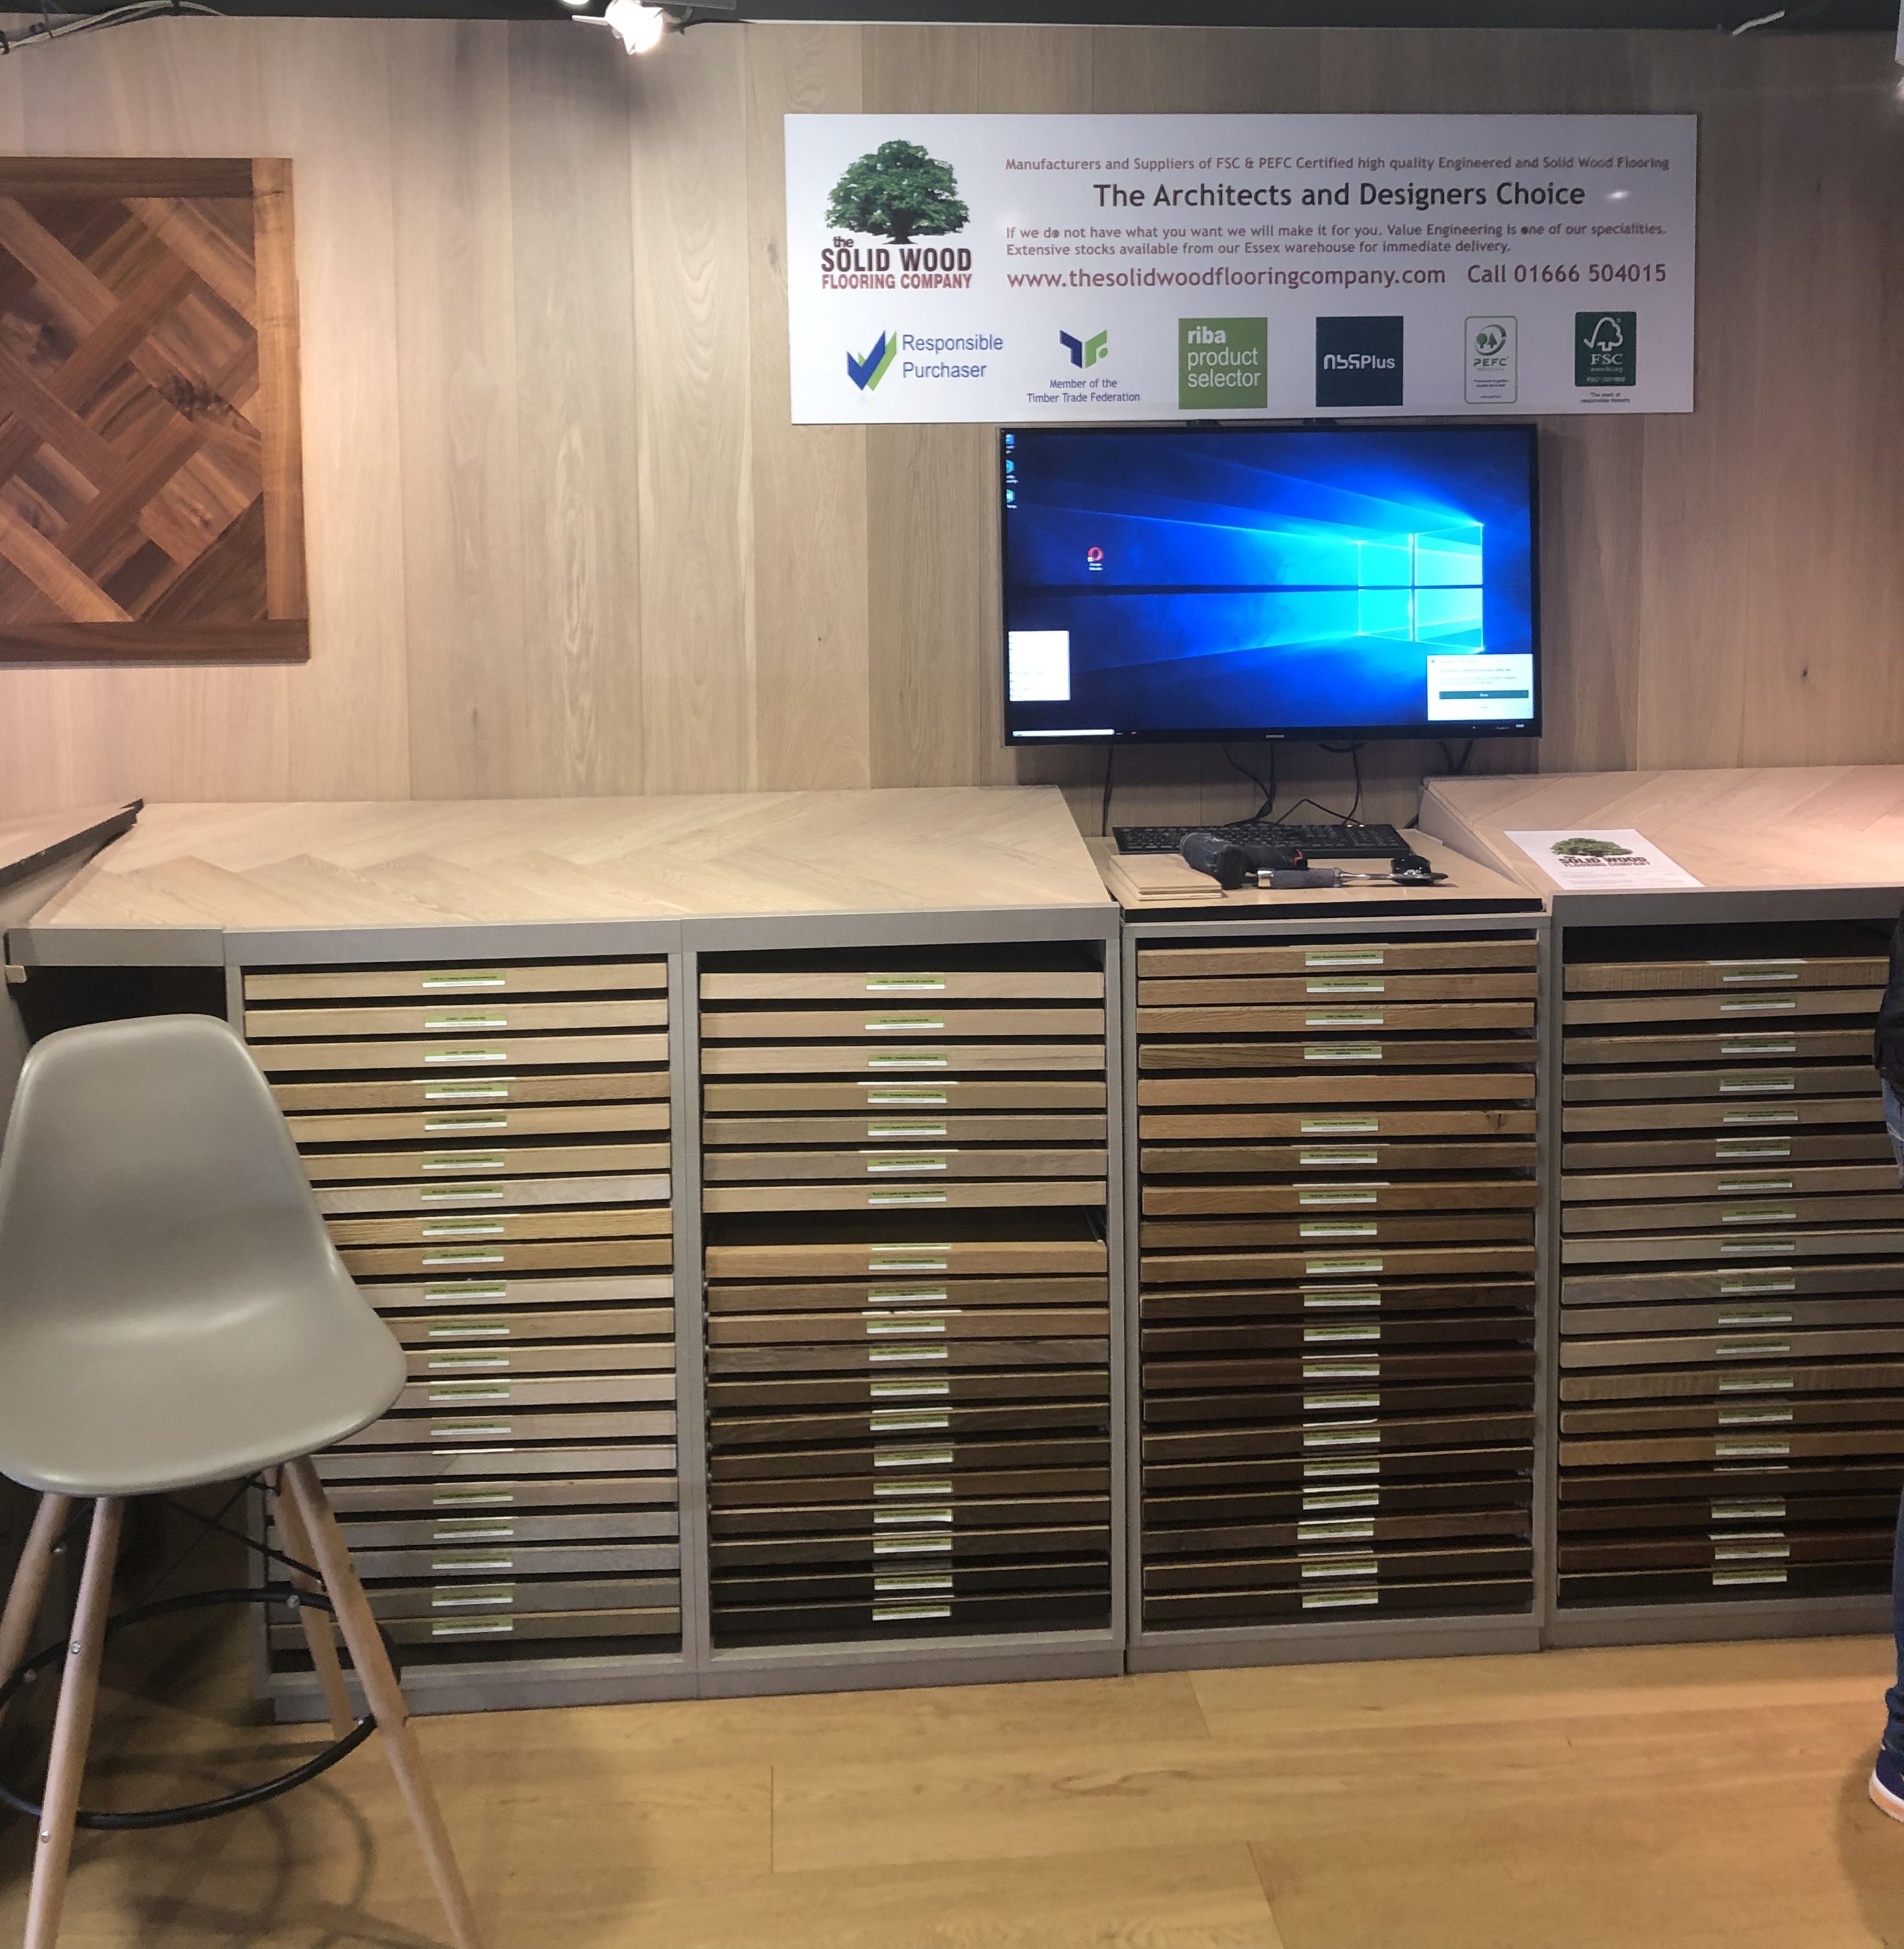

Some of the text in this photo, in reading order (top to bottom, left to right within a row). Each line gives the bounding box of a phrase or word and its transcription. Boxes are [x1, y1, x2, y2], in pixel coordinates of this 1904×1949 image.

[1006, 156, 1669, 172] Manufacturers and Suppliers of FSC & PEFC Certified high quality Engineered and Solid Wood Flooring
[1093, 182, 1585, 211] The Architects and Designers Choice
[1007, 226, 1016, 239] If
[1019, 229, 1039, 238] we
[1043, 226, 1059, 238] do
[1064, 228, 1086, 238] not
[1090, 226, 1121, 238] have
[1125, 226, 1158, 238] what
[1163, 228, 1186, 241] you
[1190, 226, 1223, 237] want
[1228, 228, 1246, 237] we
[1251, 224, 1274, 236] will
[1279, 224, 1313, 236] make
[1318, 224, 1327, 236] it
[1332, 224, 1350, 236] for
[1354, 226, 1381, 241] you.
[1387, 223, 1422, 236] Value
[1427, 223, 1503, 241] Engineering
[1507, 223, 1516, 234] is
[1521, 225, 1545, 235] one
[1548, 223, 1562, 234] of
[1566, 226, 1588, 234] our
[833, 236, 854, 248] the
[1007, 239, 1511, 255] Extensive stocks available from our Essex warehouse for immediate delivery.
[821, 248, 971, 272] SOLID WOOD
[822, 274, 972, 289] FLOORING COMPANY
[1007, 263, 1666, 289] www.thesolidwoodflooringcompany.com Call 01666 504015
[1188, 326, 1226, 344] riba
[903, 334, 1004, 354] Responsible
[1188, 347, 1258, 371] product
[1473, 358, 1507, 366] PEFC
[1591, 354, 1622, 364] FSC
[903, 361, 987, 378] Purchaser
[1188, 368, 1261, 388] selector
[1050, 378, 1117, 389] Member of the
[1027, 391, 1140, 403] Timber Trade Federation
